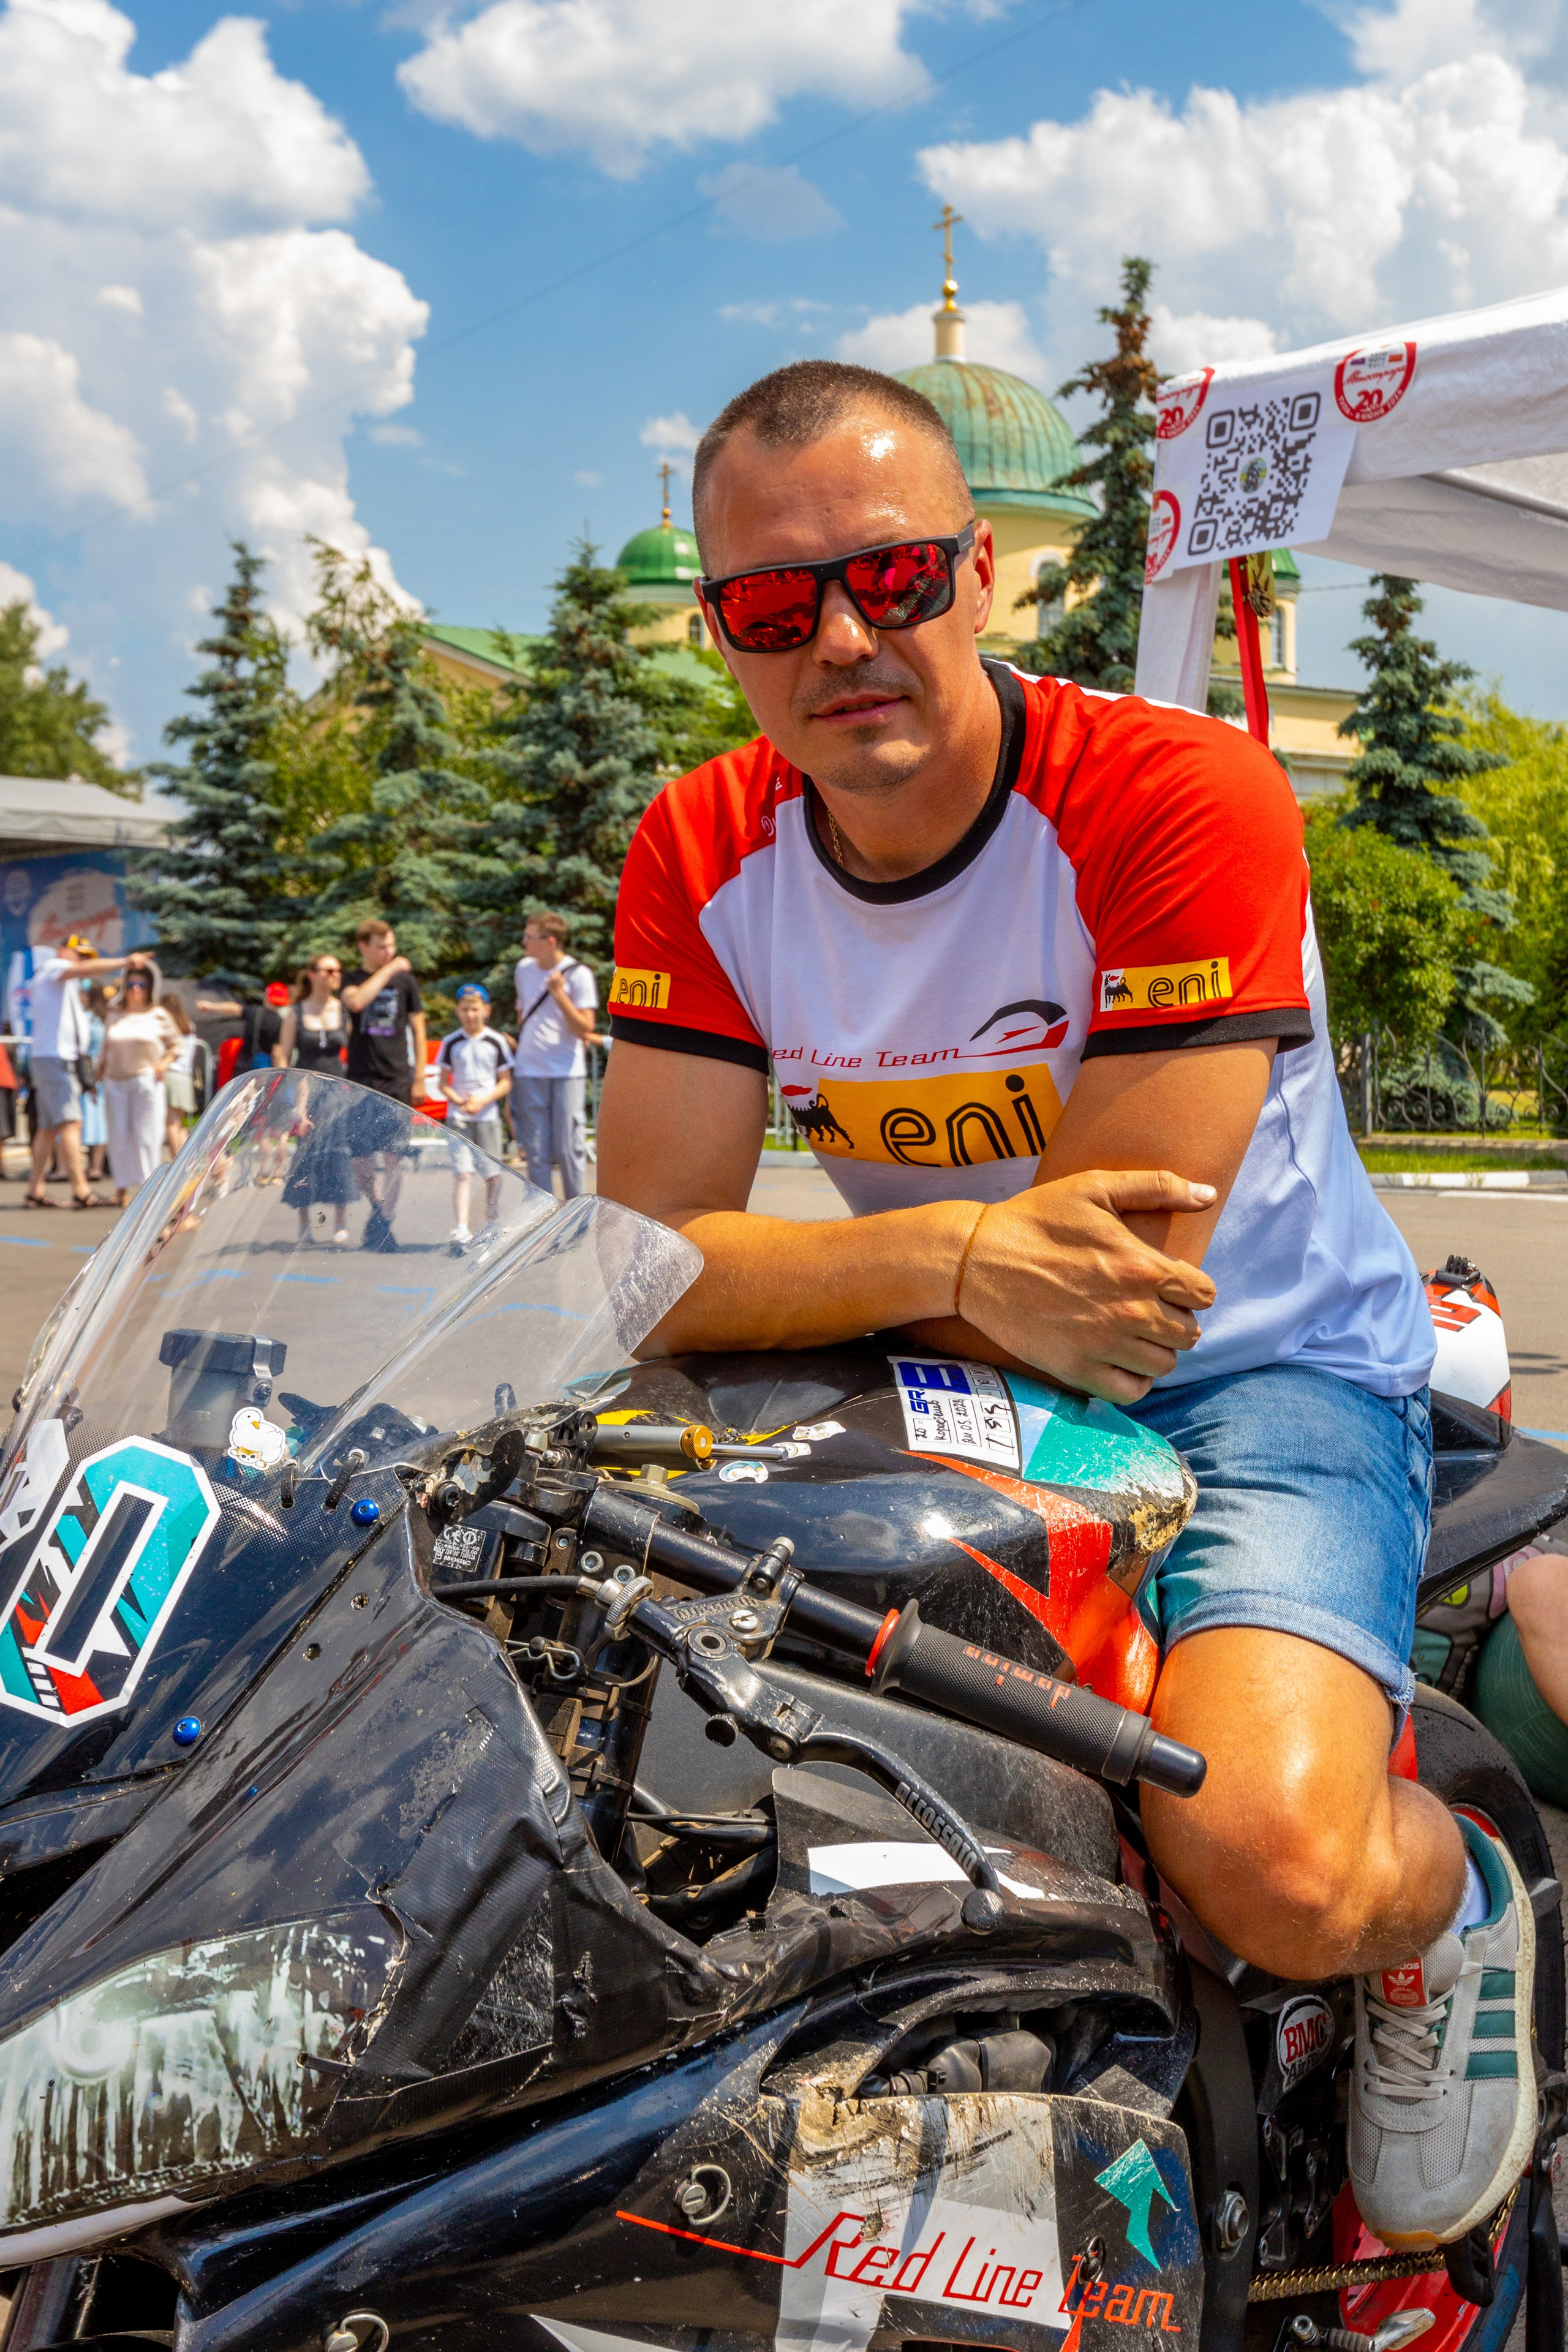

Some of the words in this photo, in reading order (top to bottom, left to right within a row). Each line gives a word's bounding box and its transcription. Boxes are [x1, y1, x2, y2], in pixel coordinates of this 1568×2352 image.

[1355, 388, 1383, 411] 20
[617, 973, 661, 1008] eni
[1147, 960, 1222, 1008] eni
[770, 1046, 804, 1060] ed
[812, 1049, 862, 1068] Line
[876, 1047, 959, 1068] Team
[880, 1074, 1047, 1167] eni
[963, 1643, 1072, 1708] domino
[895, 1781, 979, 1874] ACCOSSATO
[1284, 2013, 1329, 2063] BMC
[943, 2236, 1043, 2307] Line
